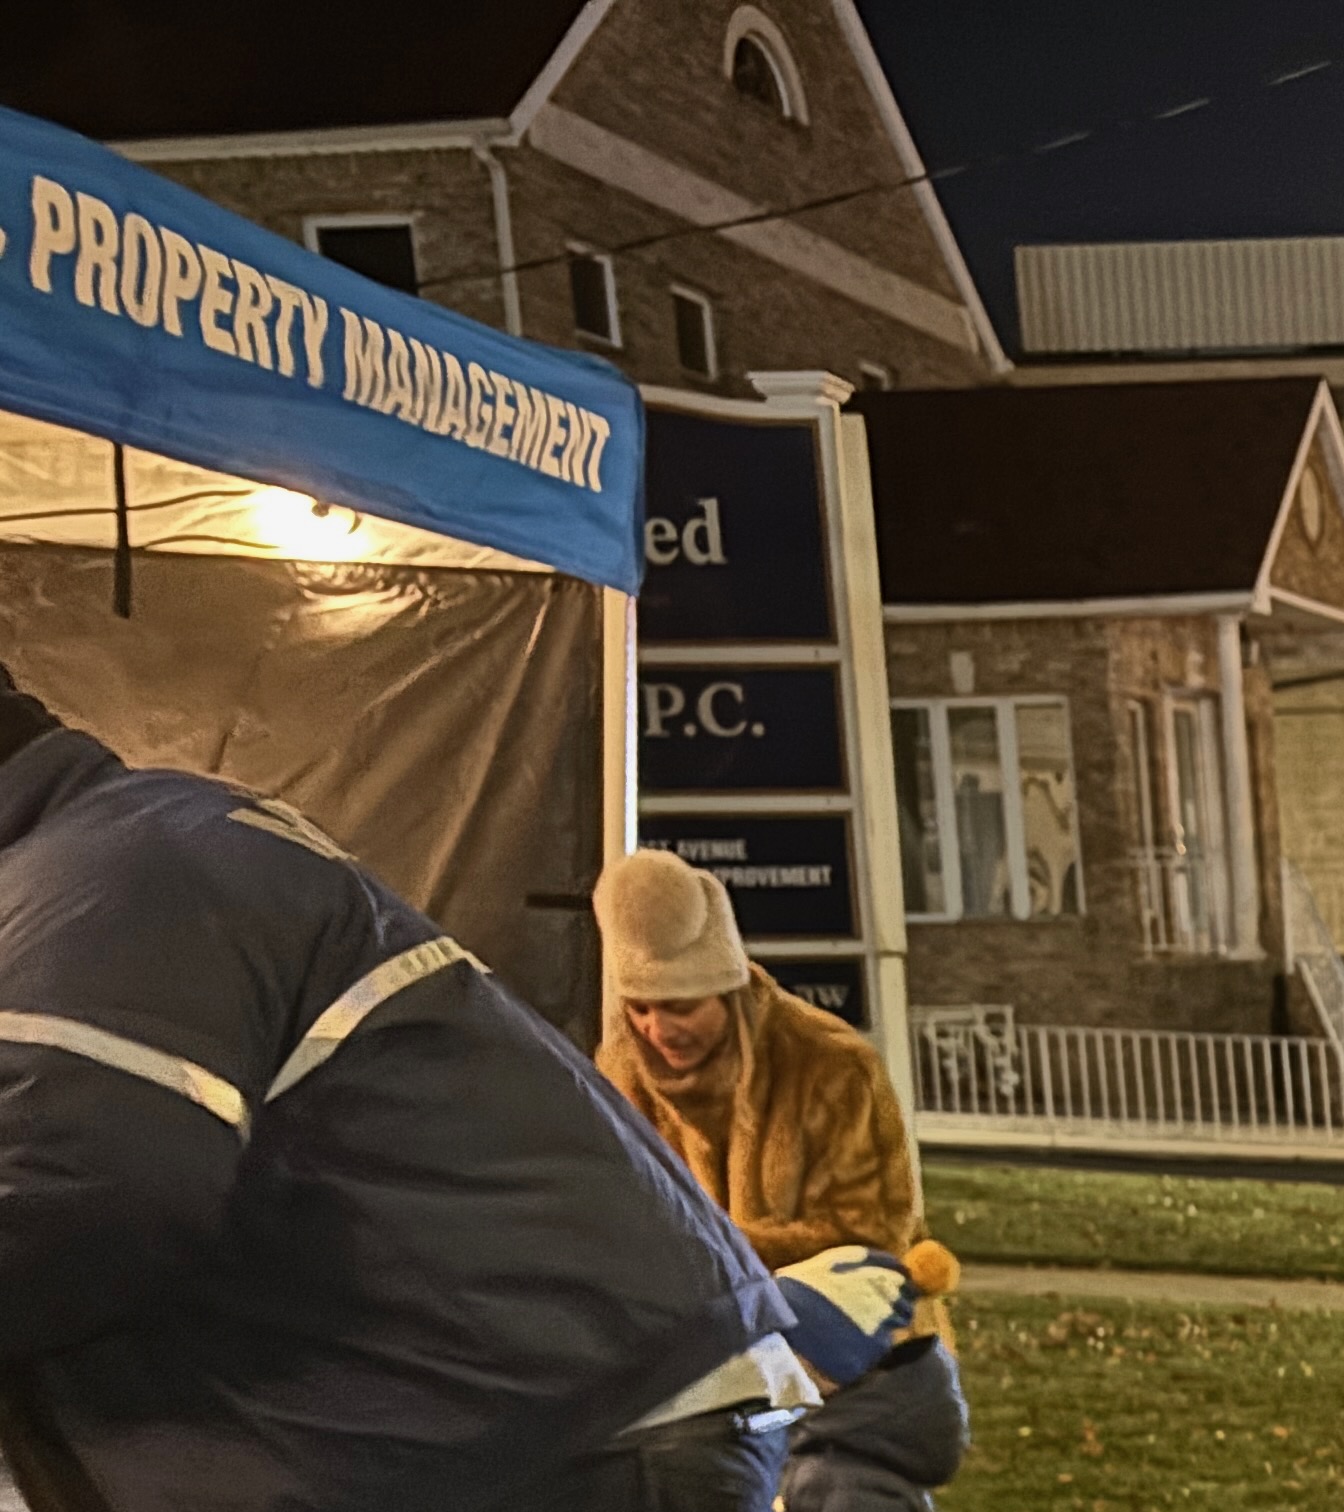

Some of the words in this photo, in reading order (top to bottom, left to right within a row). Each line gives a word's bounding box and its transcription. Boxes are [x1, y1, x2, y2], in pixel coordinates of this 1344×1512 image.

[31, 175, 328, 388] PROPERTY
[341, 307, 610, 493] MANAGEMENT
[643, 682, 765, 737] P.C.
[677, 839, 747, 861] AVENUE
